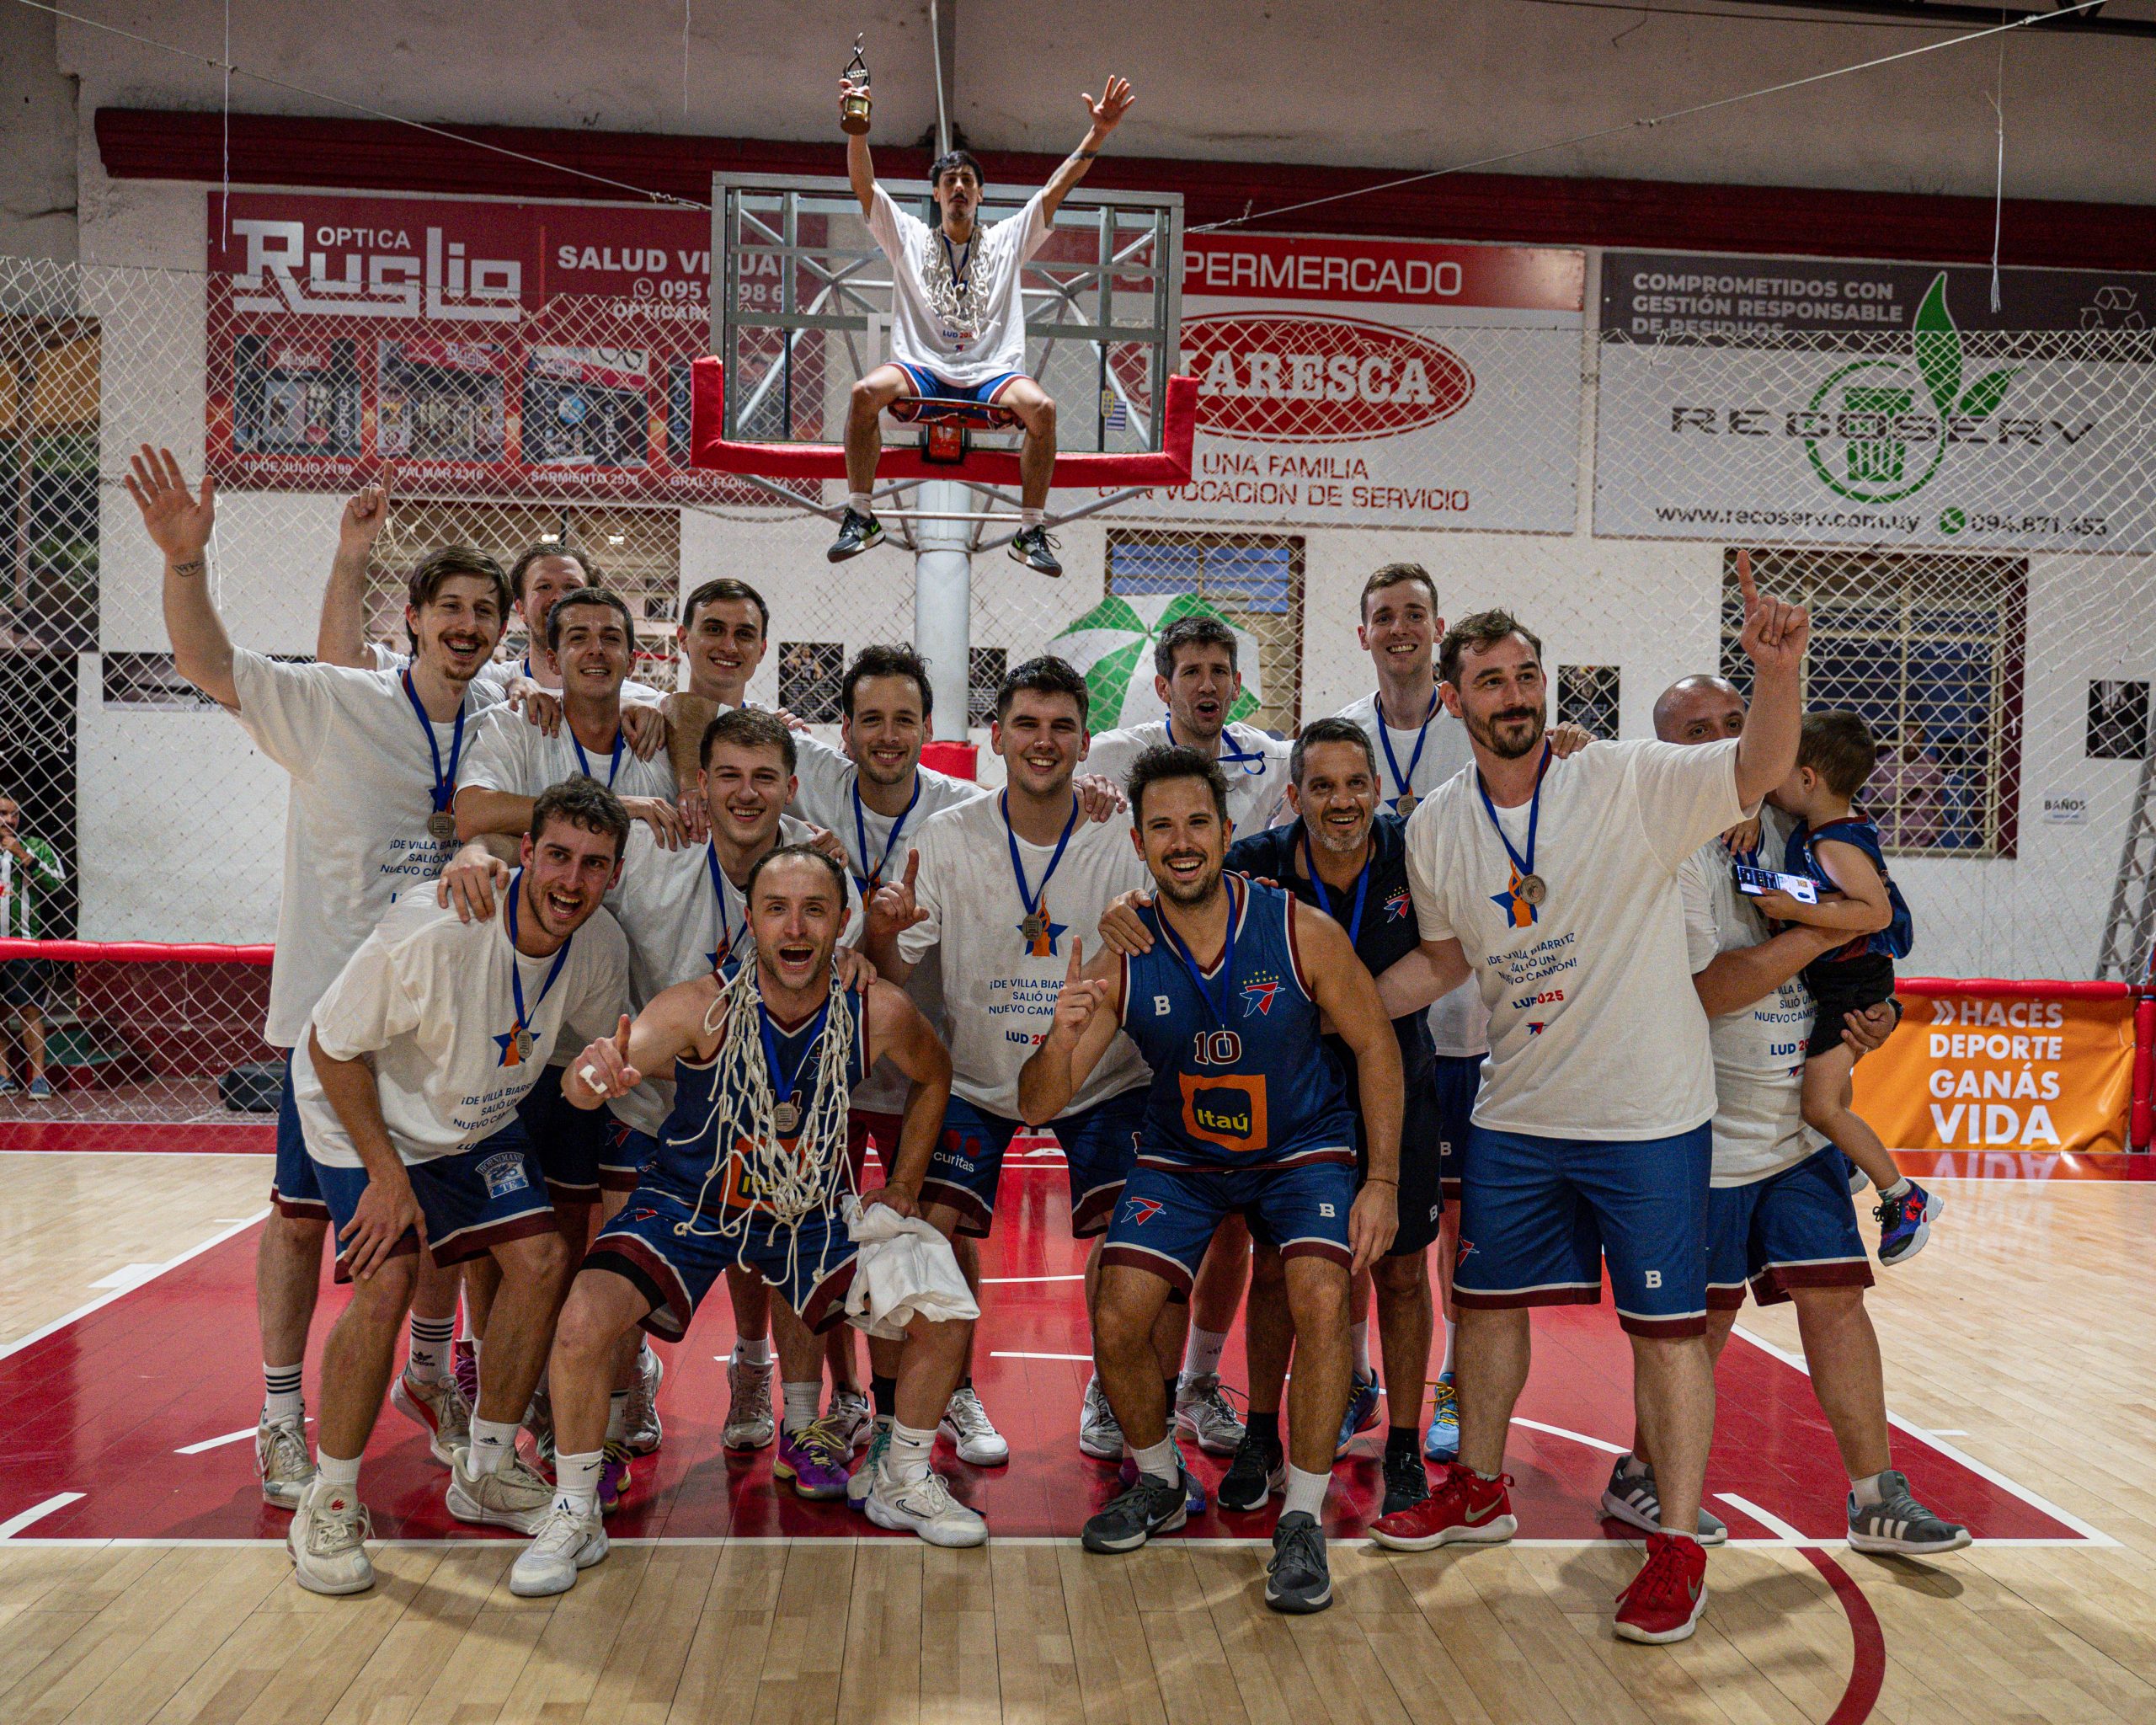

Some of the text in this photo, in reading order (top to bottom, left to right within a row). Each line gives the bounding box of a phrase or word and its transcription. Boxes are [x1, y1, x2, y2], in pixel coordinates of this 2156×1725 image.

[316, 226, 411, 249] OPTICA
[558, 245, 798, 276] SALUD VIUA
[232, 219, 522, 323] Ruglio
[1121, 249, 1462, 296] SPERMERCADO
[659, 280, 702, 299] 095
[1632, 272, 1894, 301] COMPROMETIDOS CON
[1632, 294, 1903, 323] GESTIÓN RESPONSABLE
[942, 329, 958, 338] LUD
[1632, 317, 1785, 339] DE RESIDUOS
[1671, 407, 2095, 445] RECOSERV
[259, 462, 279, 473] DE
[1203, 453, 1369, 481] UNA FAMILIA
[531, 472, 607, 484] SARMIENTO
[1308, 484, 1343, 507] DE
[1353, 487, 1470, 512] SERVICIO
[1655, 506, 1920, 534] www.recoserv.com.uy
[2044, 798, 2087, 811] BAÑOS
[408, 840, 437, 851] VILLA
[408, 852, 440, 864] SALIÓ
[380, 864, 420, 875] NUEVO
[1530, 932, 1575, 955] BIARRITZ
[1539, 954, 1556, 966] UN
[990, 980, 1007, 990] ¡DE
[1011, 979, 1038, 989] VILLA
[1012, 990, 1043, 1001] SALIÓ
[989, 1004, 1025, 1015] NUEVO
[1153, 995, 1171, 1017] B
[1960, 997, 2063, 1029] HACÉS
[1754, 1011, 1790, 1023] NUEVO
[1006, 1030, 1029, 1044] LUD
[1929, 1033, 2063, 1060] DEPORTE
[1194, 1030, 1242, 1065] 10
[1770, 1043, 1796, 1056] LUD
[1929, 1061, 2061, 1101] GANÁS
[483, 1089, 503, 1103] VILLA
[481, 1098, 505, 1116] SALIÓ
[453, 1118, 488, 1130] NUEVO
[1197, 1108, 1248, 1132] Itaú
[1929, 1103, 2062, 1146] VIDA
[1439, 1141, 1452, 1156] B
[478, 1152, 523, 1174] HORNIMANS
[1319, 1203, 1336, 1218] B
[1429, 1204, 1438, 1222] B
[1645, 1270, 1662, 1289] B
